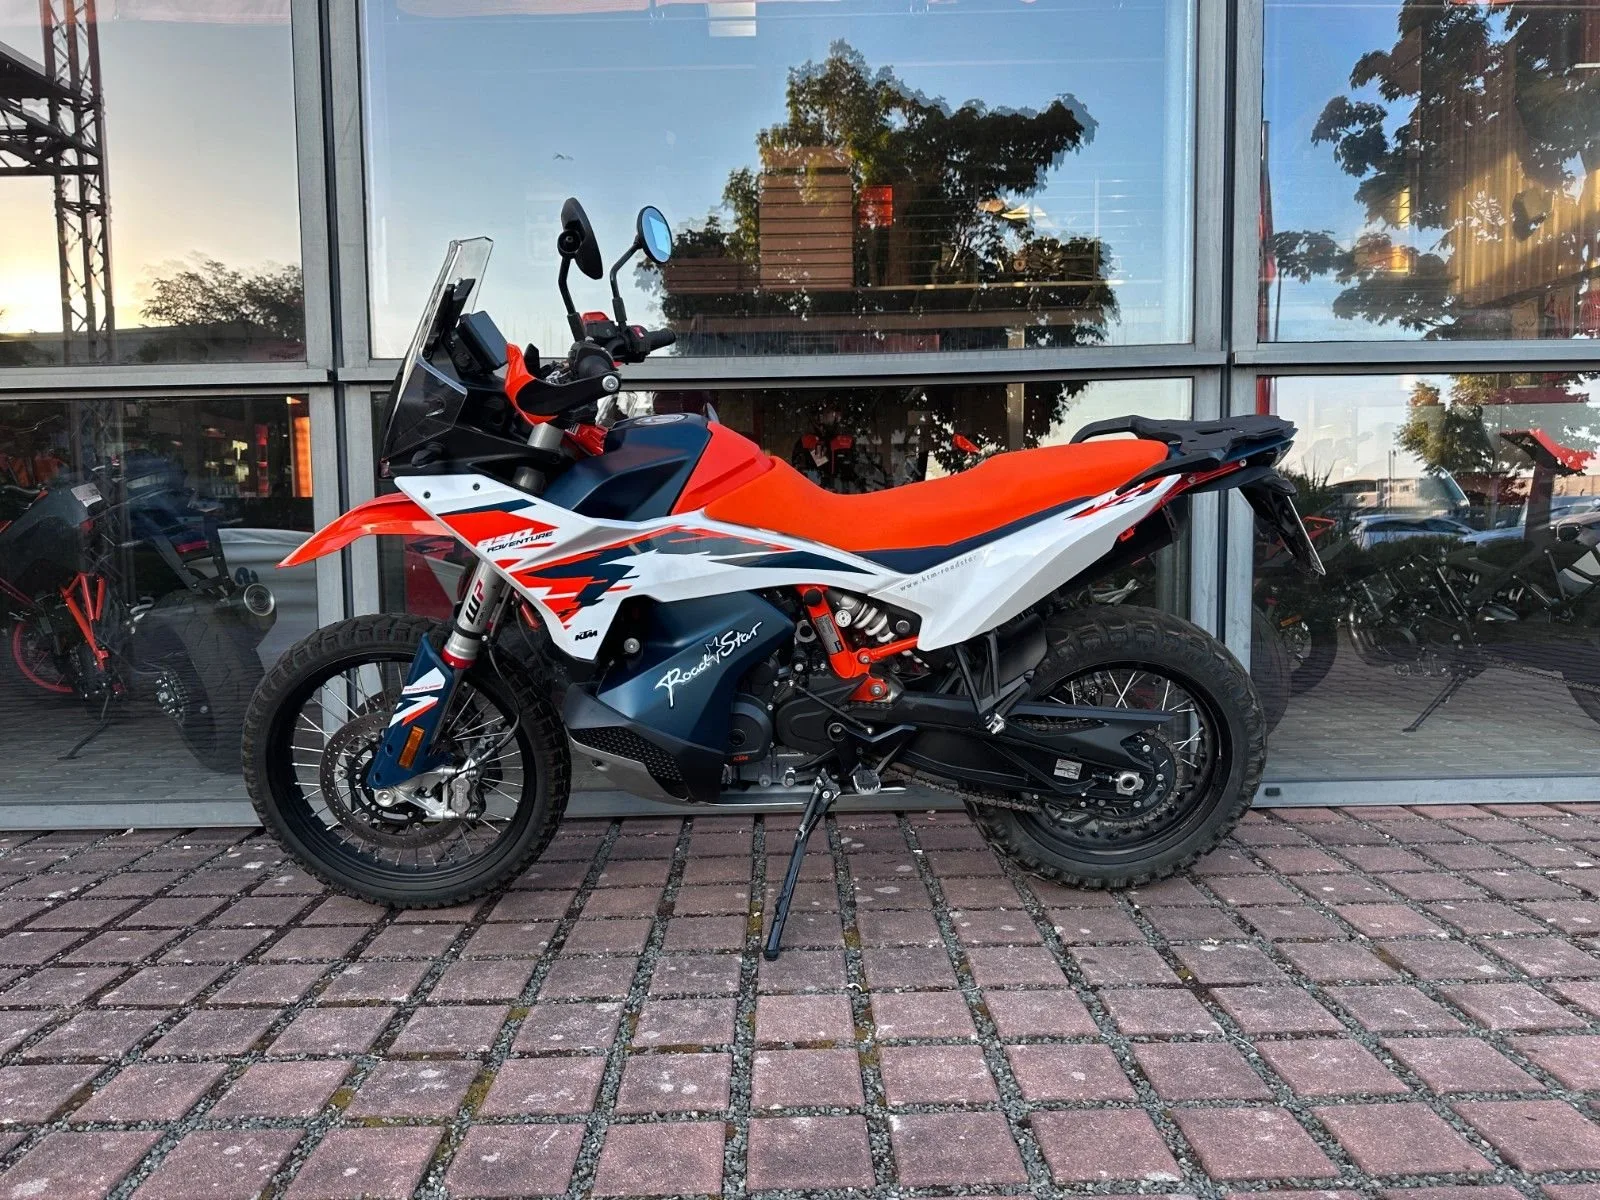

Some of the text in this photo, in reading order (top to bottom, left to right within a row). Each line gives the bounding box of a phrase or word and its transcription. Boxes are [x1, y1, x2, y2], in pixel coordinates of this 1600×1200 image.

[475, 527, 535, 548] 890
[486, 531, 553, 553] ADVENTURE
[465, 579, 484, 625] WP
[574, 629, 598, 641] KTM
[654, 653, 711, 708] Road
[720, 621, 763, 657] Star
